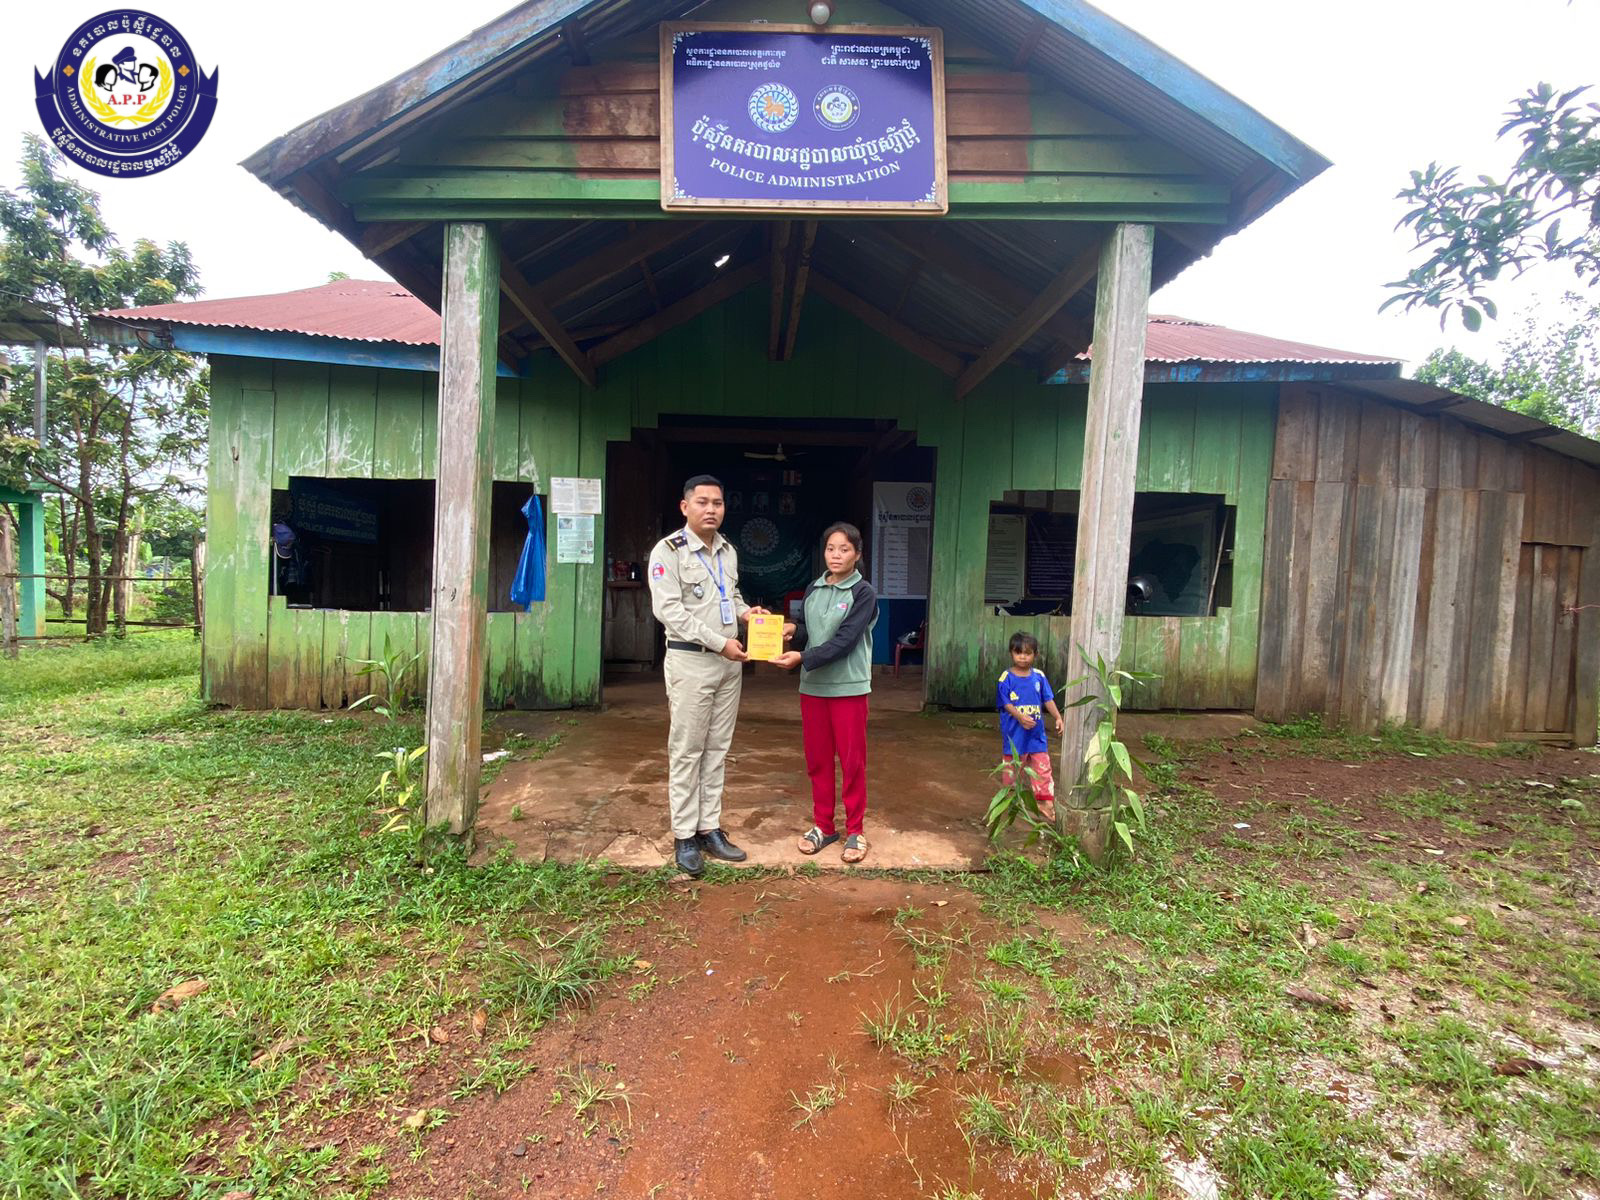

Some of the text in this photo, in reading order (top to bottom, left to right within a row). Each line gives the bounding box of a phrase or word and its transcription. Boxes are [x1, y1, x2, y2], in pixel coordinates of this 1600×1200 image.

[821, 55, 837, 65] ជាតិ
[838, 57, 869, 66] សាសនា
[709, 157, 902, 188] POLICE ADMINISTRATION
